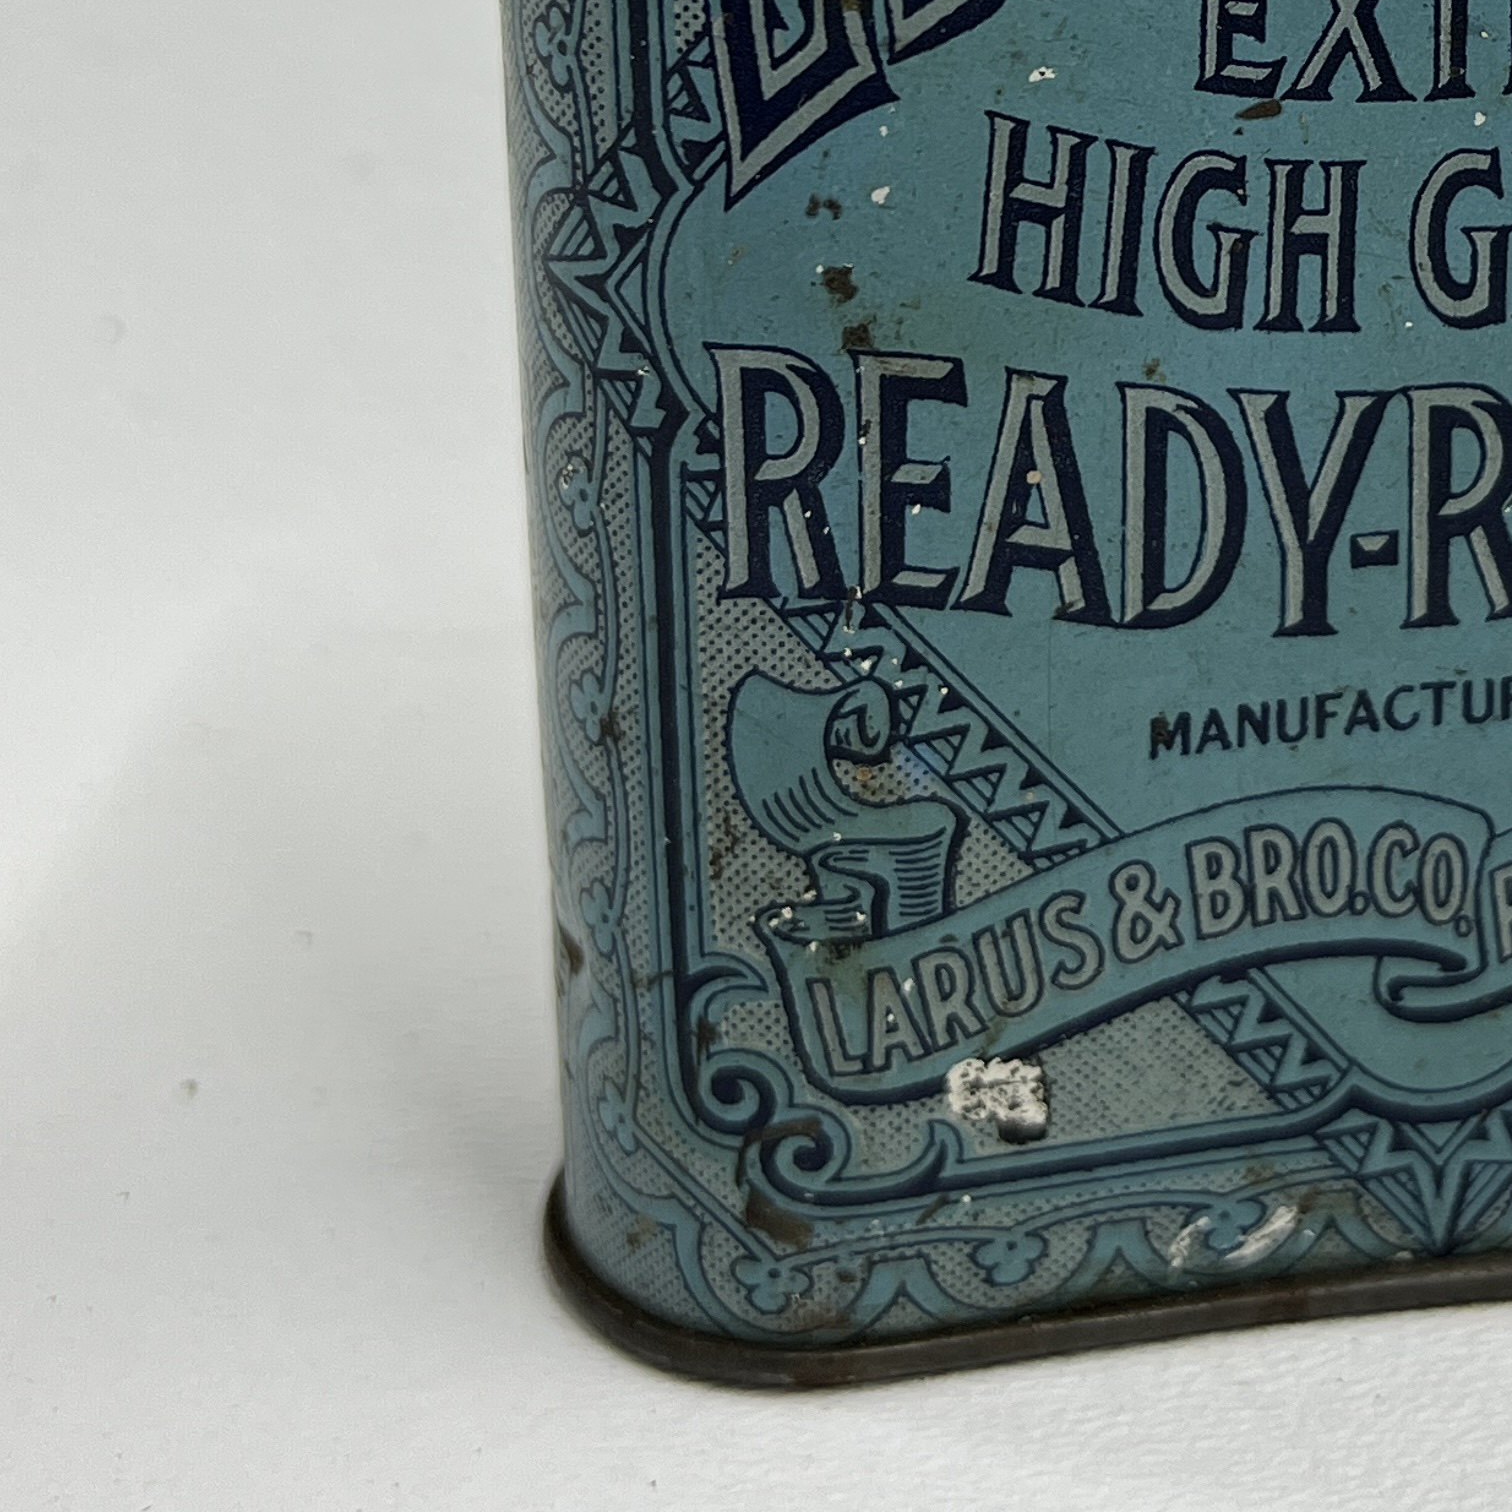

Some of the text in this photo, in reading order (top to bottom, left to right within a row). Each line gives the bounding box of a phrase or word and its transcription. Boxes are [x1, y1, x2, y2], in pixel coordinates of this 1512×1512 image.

[967, 109, 1367, 333] HIGH
[806, 892, 1106, 1078] LARUS
[1108, 858, 1185, 964] &
